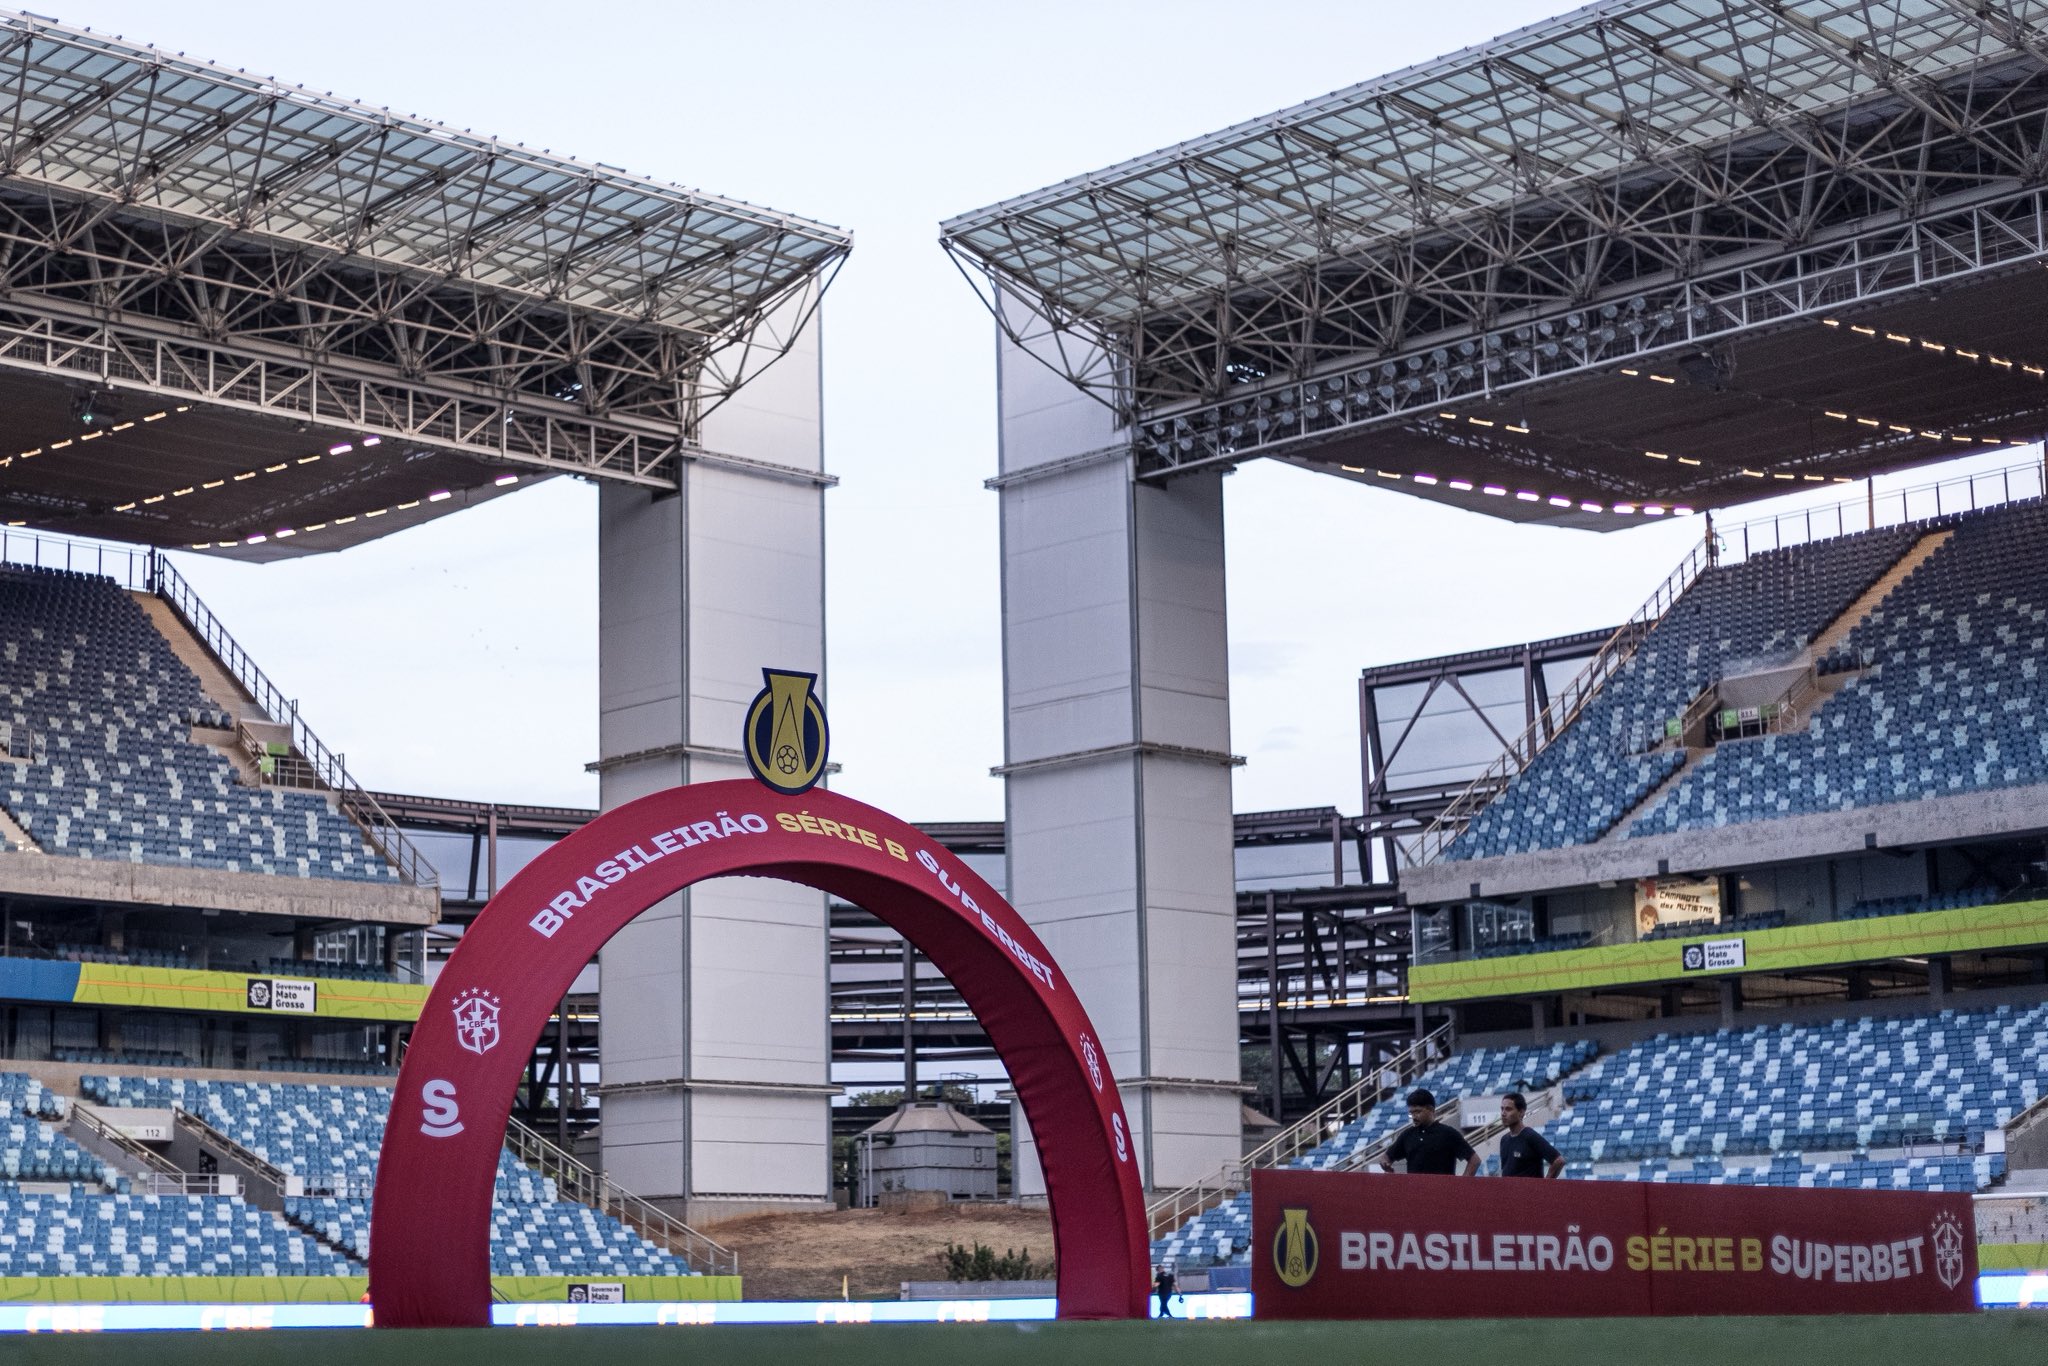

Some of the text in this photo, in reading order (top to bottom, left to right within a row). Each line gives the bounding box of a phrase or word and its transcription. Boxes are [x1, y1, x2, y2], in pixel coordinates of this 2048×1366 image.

[529, 811, 1055, 990] BRASILEIRÃO SÉRIE B SUPERBET
[1708, 951, 1728, 959] Mato
[1708, 959, 1735, 967] Grosso
[275, 991, 298, 1000] Mato
[275, 1000, 305, 1009] Grosso
[145, 1129, 160, 1137] 112
[1341, 1225, 1925, 1283] BRASILEIRÃO SÉRIE B SUPERBET
